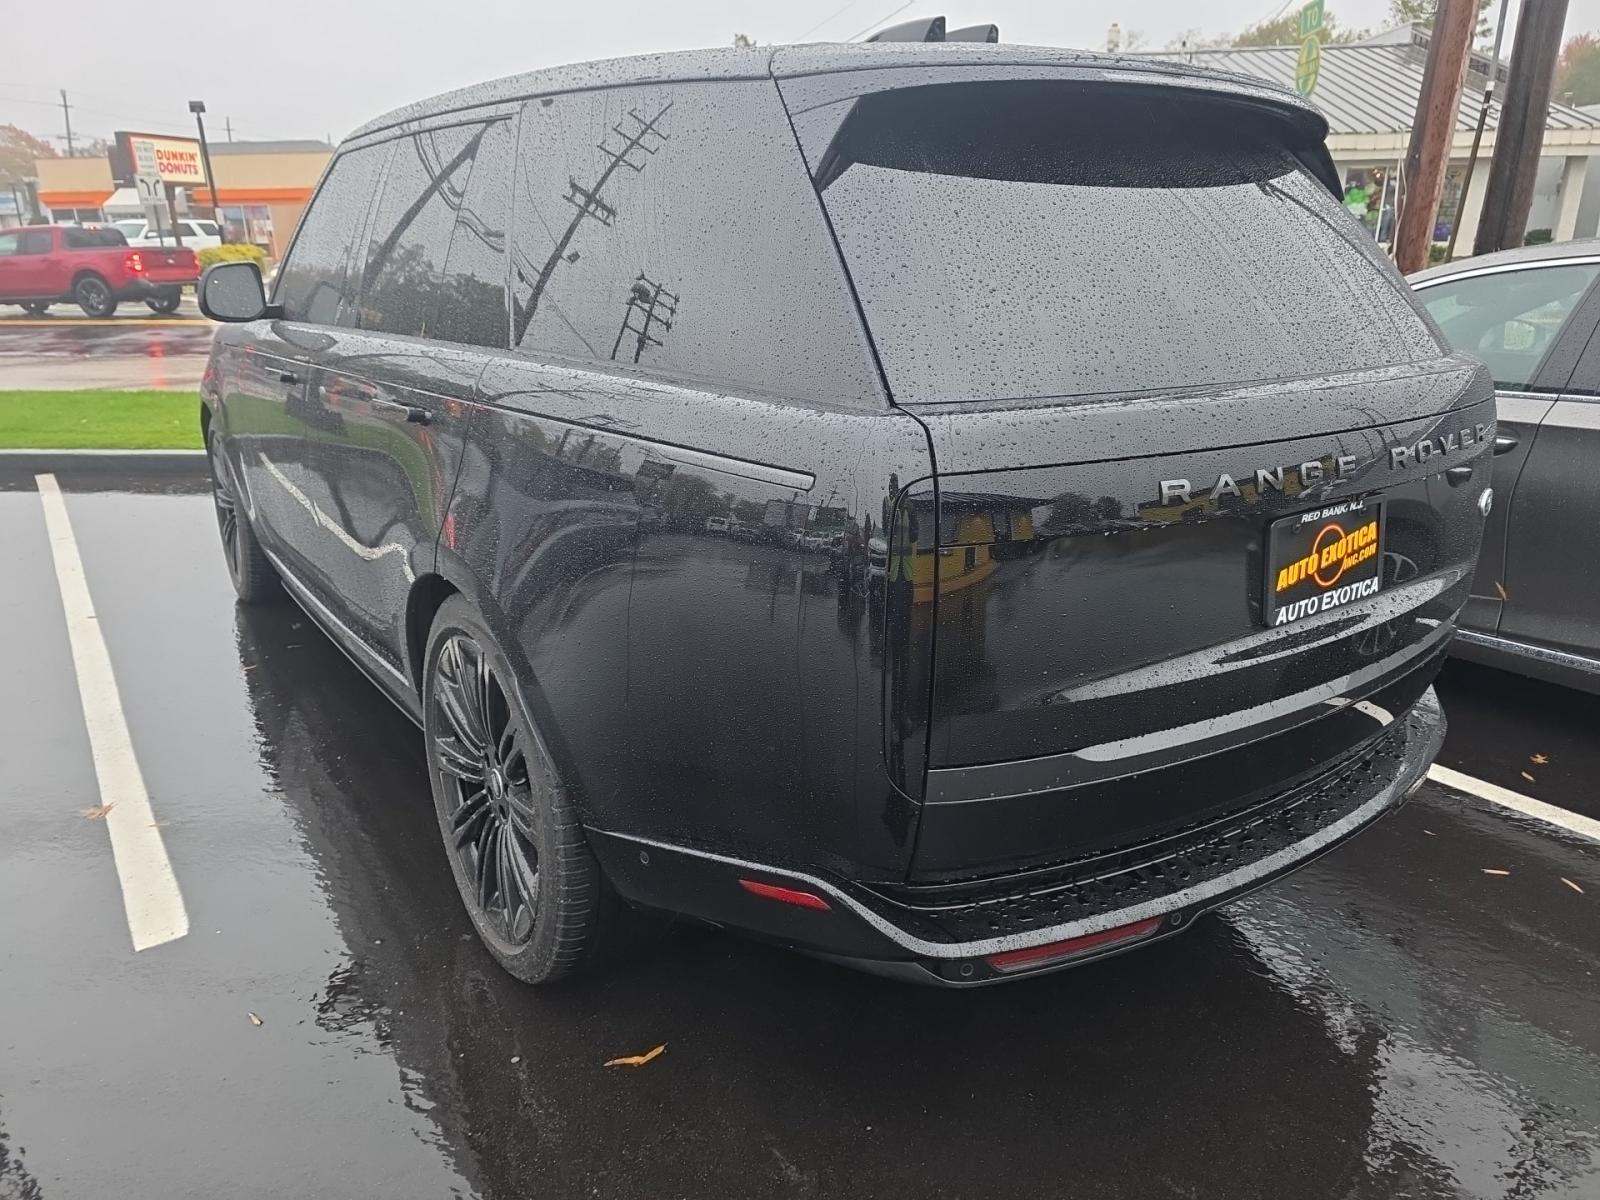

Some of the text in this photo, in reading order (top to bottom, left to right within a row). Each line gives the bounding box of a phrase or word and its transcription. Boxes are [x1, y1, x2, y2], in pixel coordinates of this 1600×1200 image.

[156, 150, 198, 161] DUNKIN'
[159, 163, 199, 175] DONUTS
[1160, 422, 1492, 505] RANGE ROVER
[1301, 511, 1321, 524] RED
[1276, 521, 1377, 592] AUTO EXOTICA
[1276, 576, 1379, 626] AUTO EXOTICA
